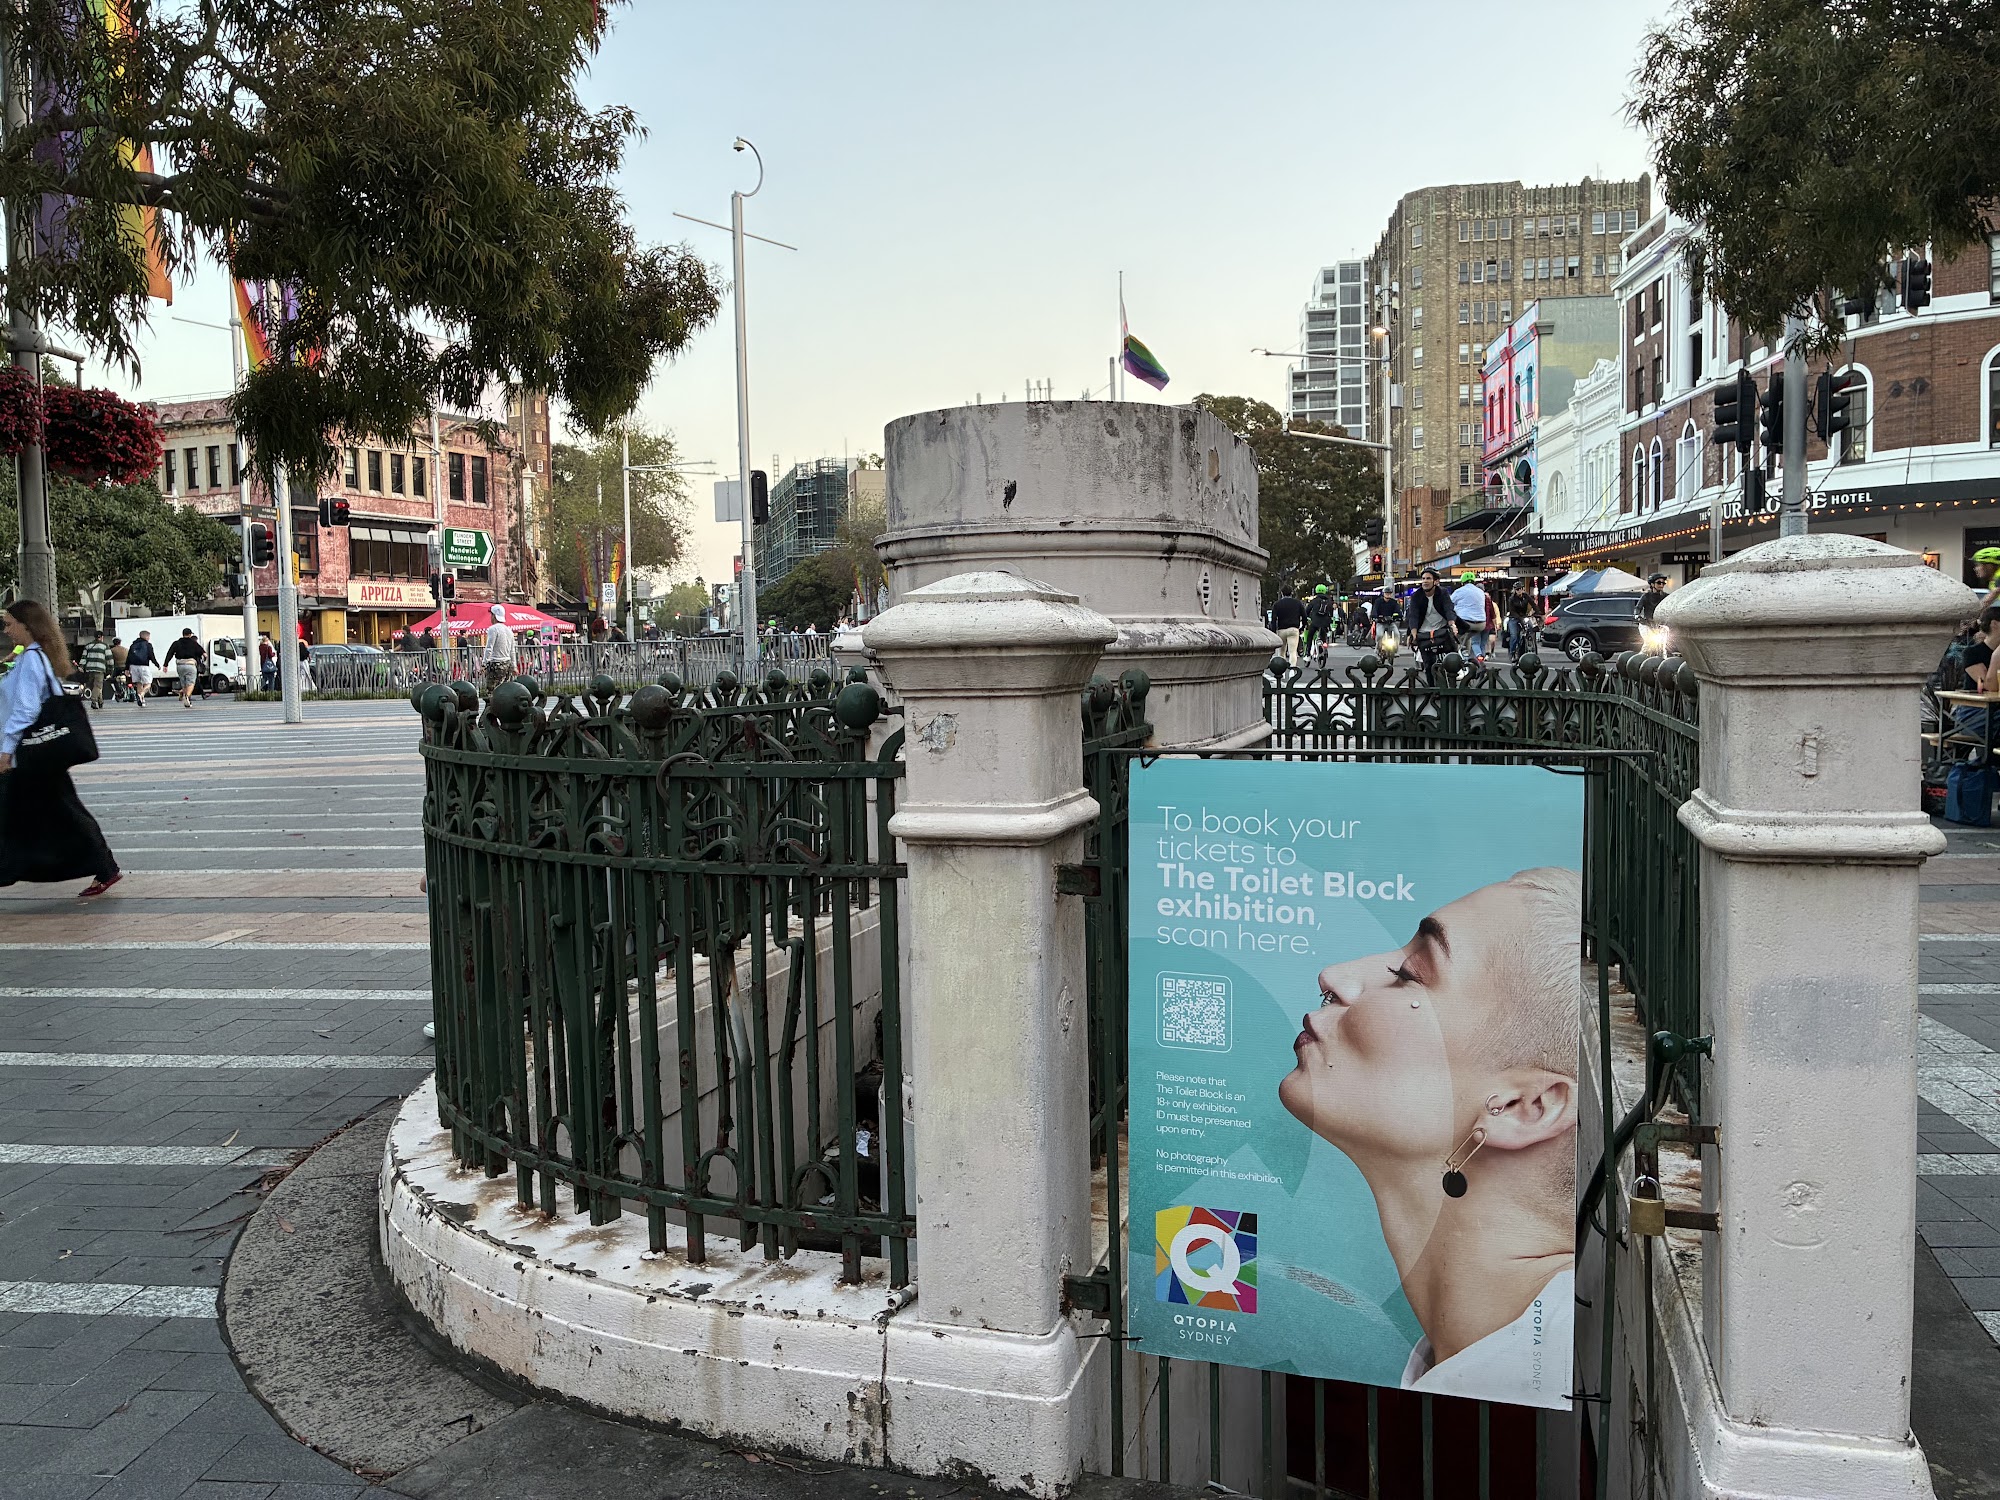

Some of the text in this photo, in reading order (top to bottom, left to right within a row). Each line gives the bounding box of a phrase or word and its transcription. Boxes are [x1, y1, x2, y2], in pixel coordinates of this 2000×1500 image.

[1699, 512, 1708, 521] THE
[1831, 492, 1873, 505] HOTEL
[454, 532, 475, 540] FLINDERS
[1542, 533, 1583, 541] JUDGEMENT
[1579, 541, 1585, 551] IN
[1586, 535, 1608, 550] SESSION
[1609, 529, 1626, 545] SINCE
[447, 553, 481, 564] Wollongong
[450, 545, 479, 555] Randwick
[1673, 554, 1689, 562] BAR
[360, 585, 403, 602] APPIZZA
[1157, 805, 1361, 843] To book your
[1157, 834, 1297, 866] tickets to
[1157, 862, 1416, 902] The Toilet Block
[1157, 892, 1322, 931] exhibition,
[1157, 923, 1317, 955] scan here.
[1156, 1071, 1227, 1087] Please note that
[1156, 1083, 1246, 1102] The Toilet Block is an
[1156, 1096, 1238, 1114] 18+ only exhibition.
[1156, 1109, 1251, 1129] ID must be presented
[1156, 1125, 1206, 1139] upon entry.
[1156, 1148, 1229, 1166] No photography
[1156, 1161, 1284, 1185] is permitted in this exhibition.
[1170, 1223, 1242, 1296] Q
[1173, 1314, 1237, 1333] QTOPIA
[1179, 1329, 1232, 1346] SYDNEY
[1532, 1299, 1542, 1393] QTOPIA SYDNEY
